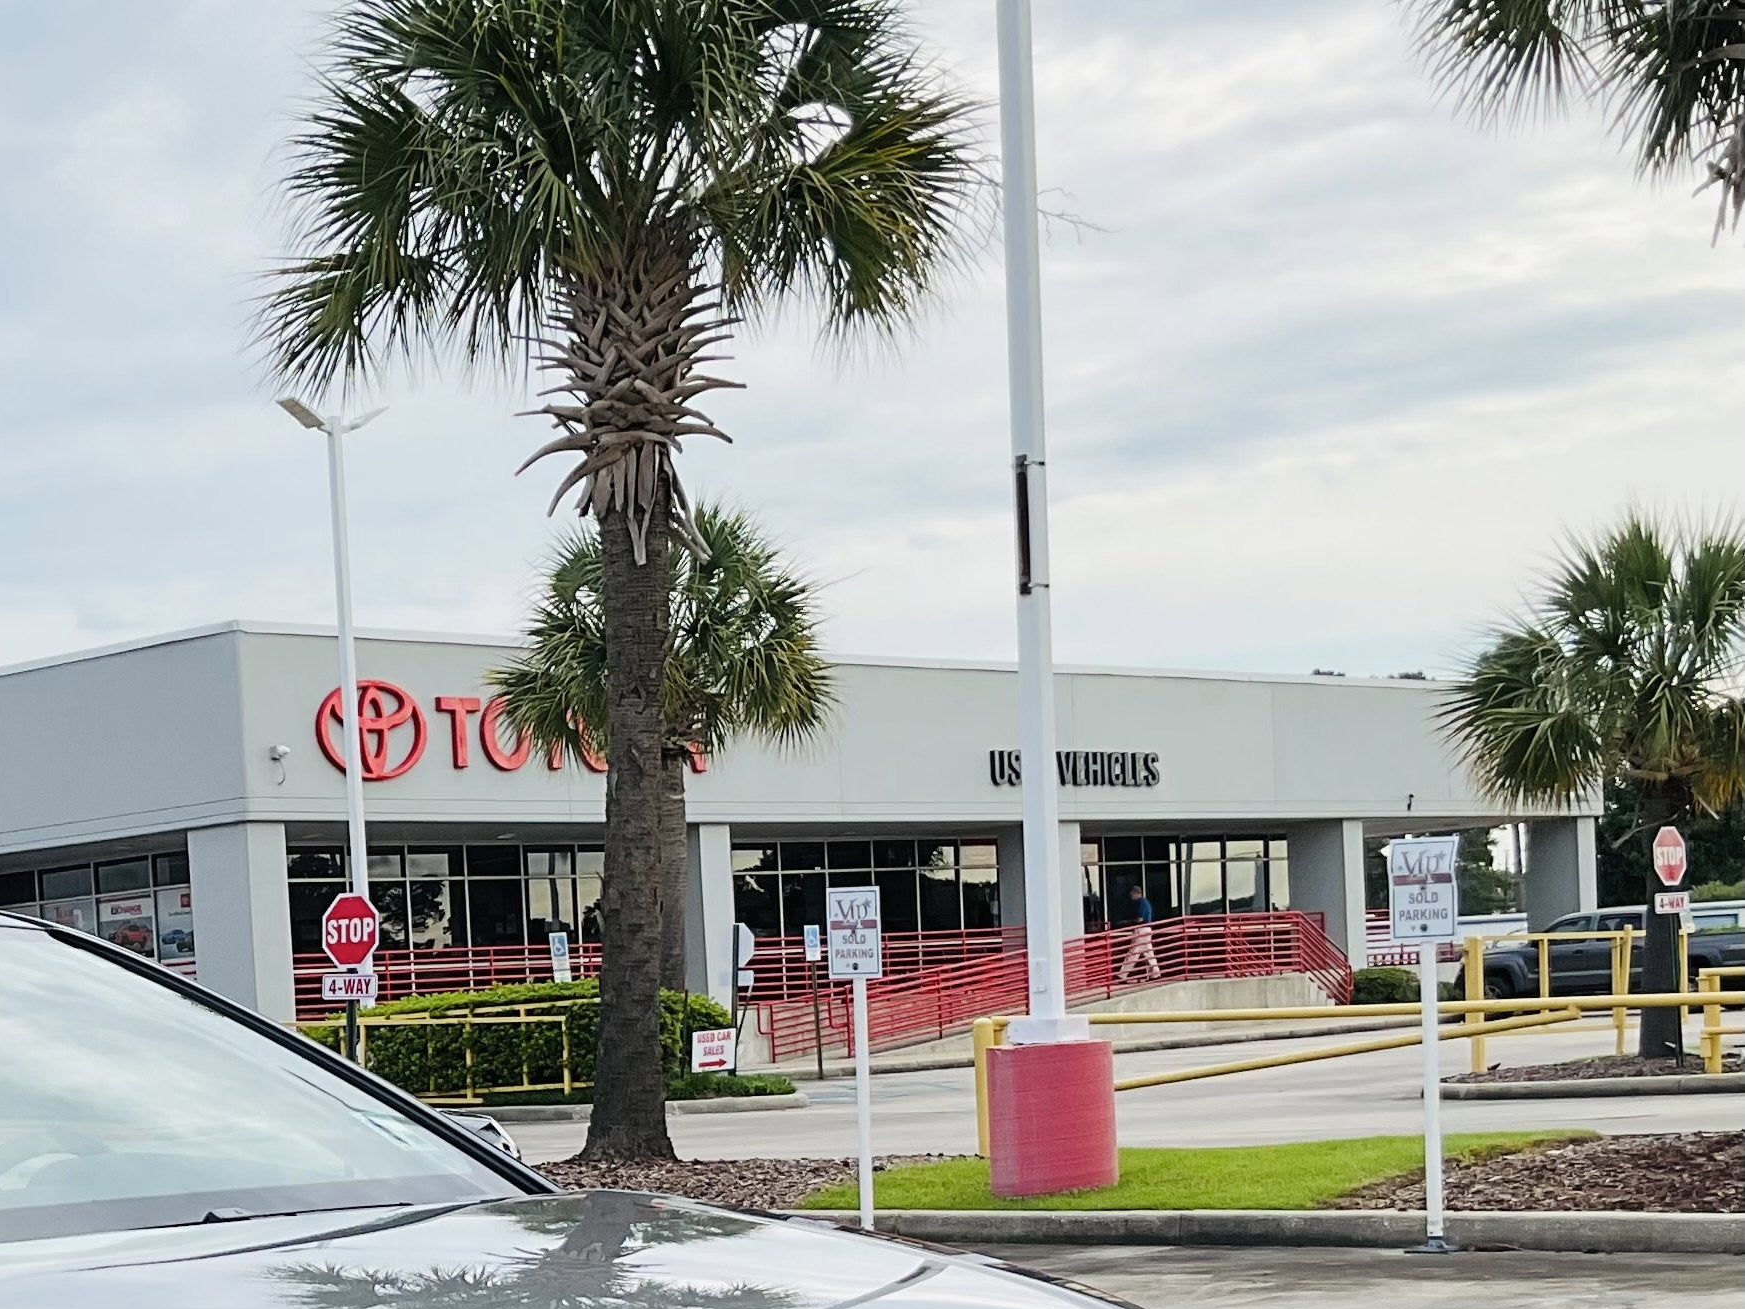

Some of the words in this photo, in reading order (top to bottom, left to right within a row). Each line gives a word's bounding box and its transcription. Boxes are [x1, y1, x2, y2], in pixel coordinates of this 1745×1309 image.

[989, 750, 1021, 786] US
[1055, 751, 1160, 787] VEHICLES
[1656, 847, 1683, 866] STOP
[1408, 892, 1438, 904] SOLD
[1659, 896, 1684, 909] 4-WAY
[1399, 908, 1448, 920] PARKING
[327, 917, 374, 945] STOP
[842, 935, 866, 945] SOLD
[835, 949, 874, 959] PARKING
[328, 979, 371, 995] 4-WAY
[697, 1032, 715, 1043] USED
[717, 1031, 732, 1041] CAR
[703, 1045, 724, 1056] SALES
